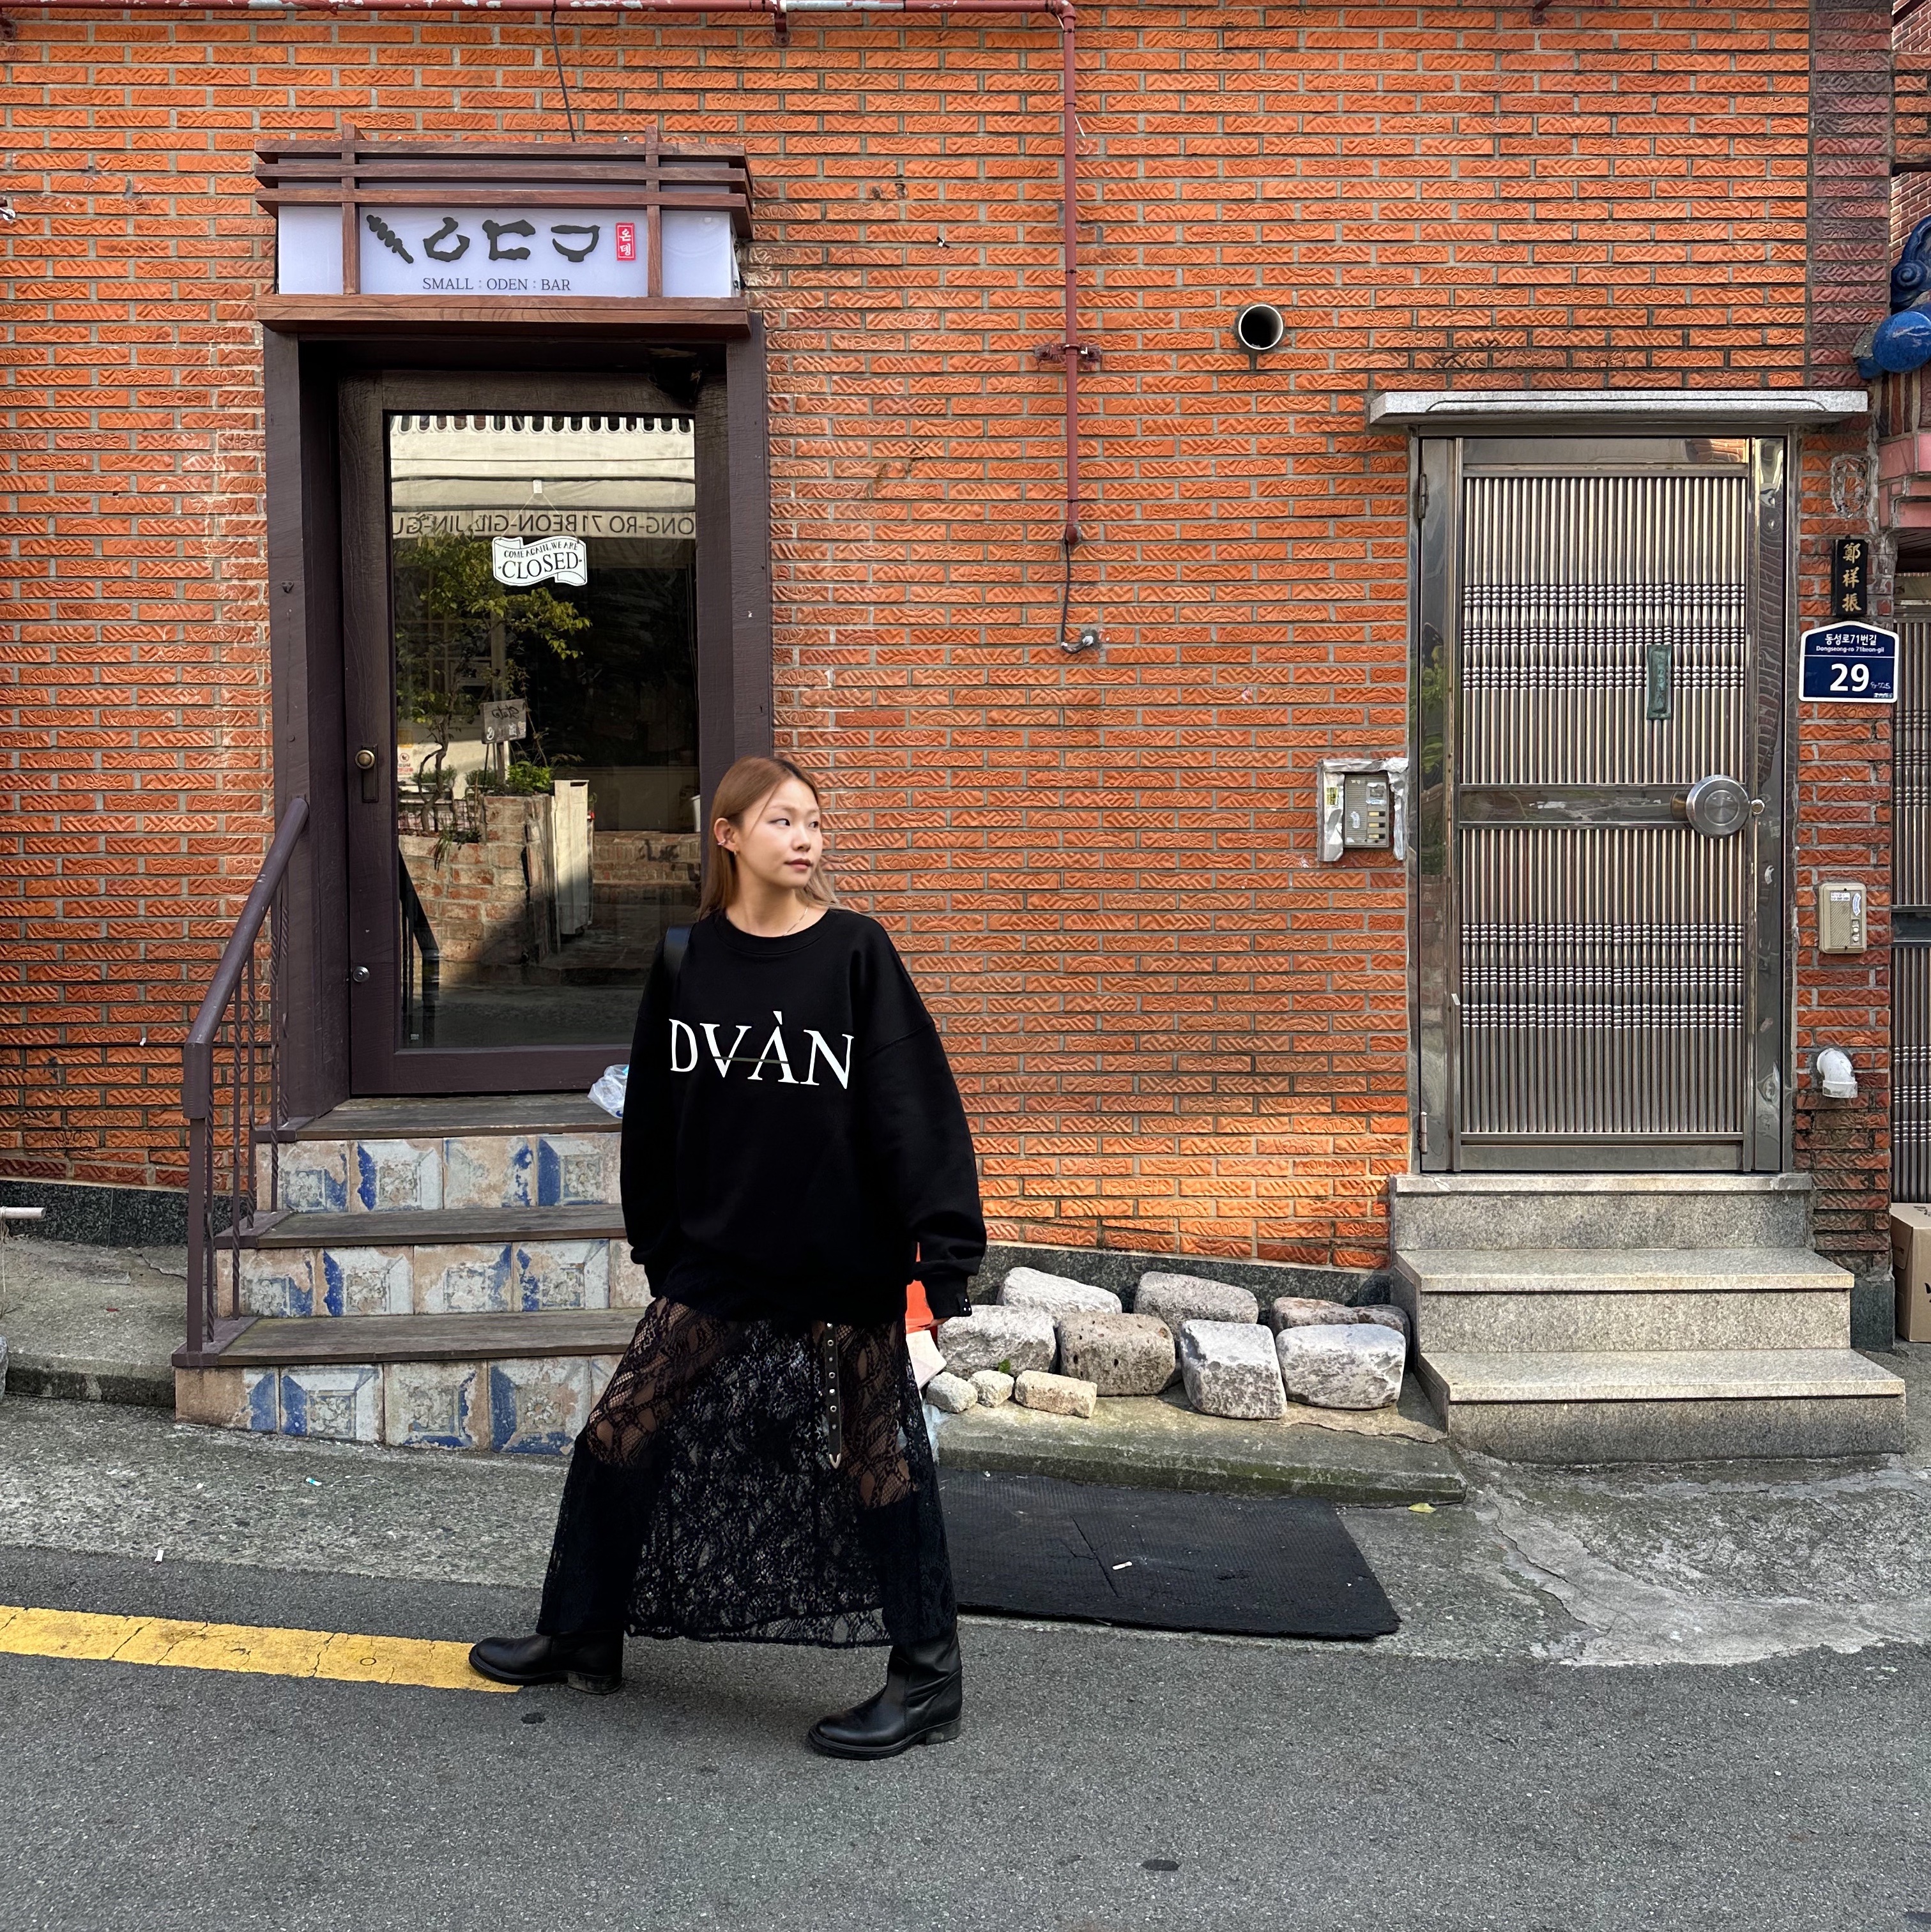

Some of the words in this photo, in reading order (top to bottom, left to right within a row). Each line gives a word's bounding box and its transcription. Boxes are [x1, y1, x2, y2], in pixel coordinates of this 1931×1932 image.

[422, 277, 474, 290] SMALL
[486, 278, 528, 291] ODEN
[541, 278, 571, 291] BAR
[504, 550, 524, 558] COME
[551, 542, 561, 550] WE
[563, 542, 578, 551] ARE
[502, 552, 579, 579] CLOSED
[1842, 543, 1862, 612] 鄭祥振
[1825, 634, 1877, 646] 동성로71번길
[1830, 663, 1870, 692] 29
